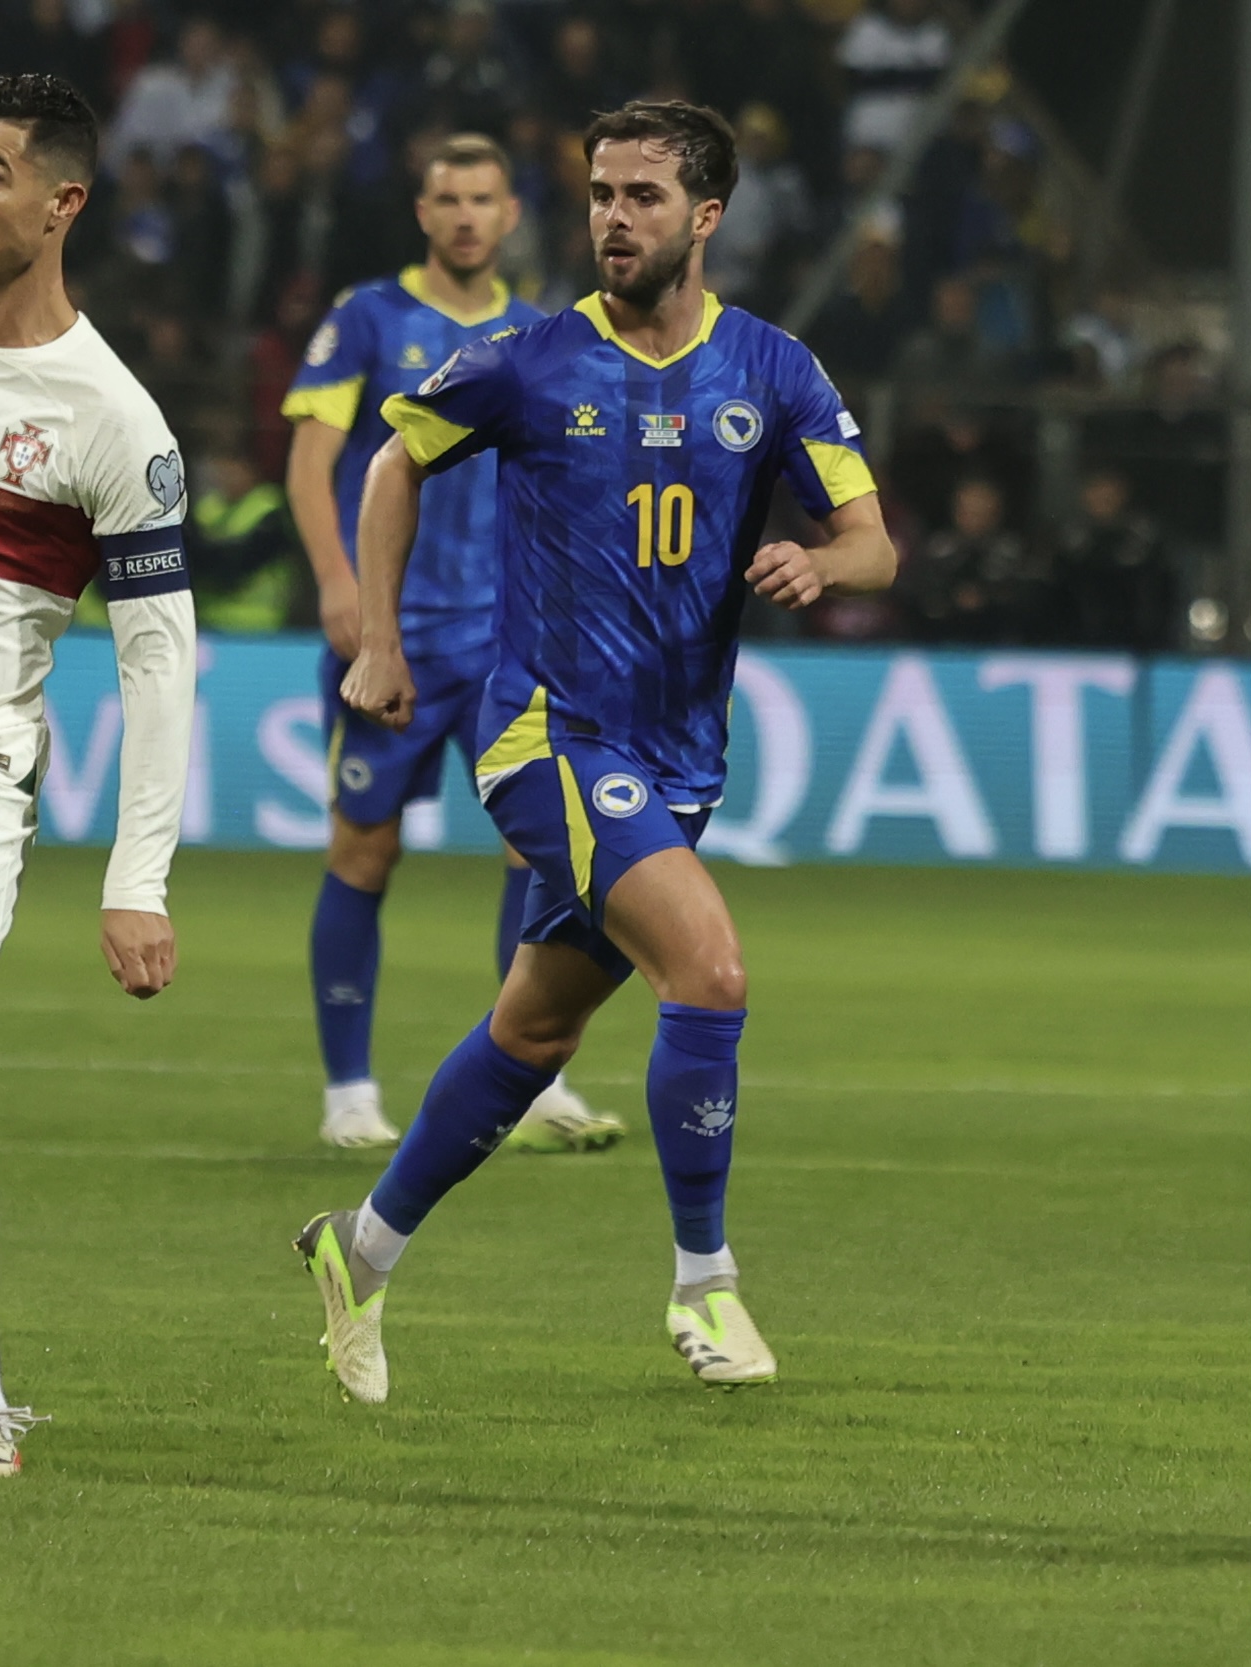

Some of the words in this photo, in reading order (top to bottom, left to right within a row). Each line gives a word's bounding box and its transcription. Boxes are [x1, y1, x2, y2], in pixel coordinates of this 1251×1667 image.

[565, 426, 607, 437] KELME
[626, 483, 694, 568] 10
[126, 553, 182, 574] RESPECT
